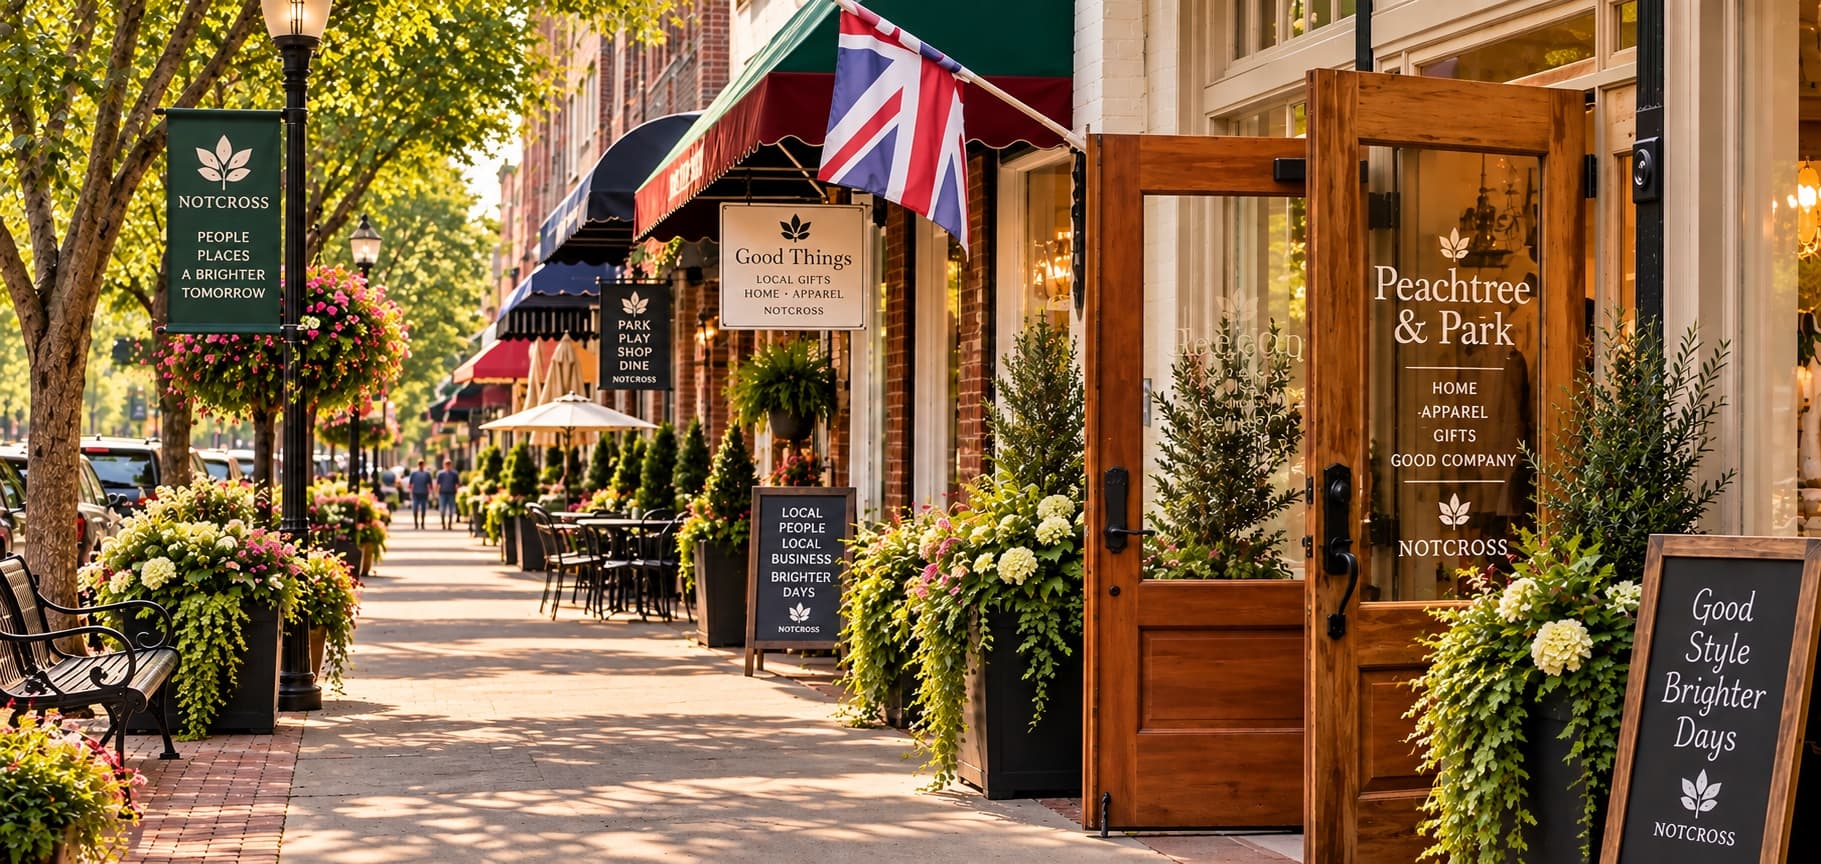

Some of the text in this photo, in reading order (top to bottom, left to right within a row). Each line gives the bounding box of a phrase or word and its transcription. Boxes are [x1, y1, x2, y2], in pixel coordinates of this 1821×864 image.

[179, 196, 268, 208] NOTCROSS
[198, 232, 249, 242] PEOPLE
[198, 250, 249, 261] PLACES
[736, 248, 851, 270] Good Things
[182, 269, 265, 280] A BRIGHTER
[757, 274, 831, 285] LOCAL GIFTS
[1374, 266, 1530, 304] Peachtree
[182, 288, 265, 298] TOMORROW
[745, 289, 844, 299] HOME APPAREL
[765, 306, 824, 316] NOTCROSS
[619, 320, 650, 330] PARK
[1395, 309, 1514, 345] & Park
[619, 334, 650, 343] PLAY
[618, 347, 652, 357] SHOP
[620, 361, 648, 370] DINE
[1433, 382, 1477, 394] HOME
[1434, 429, 1475, 442] GIFTS
[1391, 454, 1516, 466] GOOD COMPANY
[783, 508, 822, 518] LOCAL
[780, 523, 825, 533] PEOPLE
[783, 538, 821, 548] LOCAL
[1398, 538, 1508, 558] NOTCROSS
[772, 554, 831, 564] BUSINESS
[772, 572, 830, 582] BRIGHTER
[784, 587, 814, 597] DAYS
[1693, 588, 1755, 625] Good
[1686, 631, 1749, 673] Style
[1662, 672, 1766, 714] Brighter
[1674, 715, 1736, 762] Days
[1654, 822, 1735, 846] NOTCROSS
